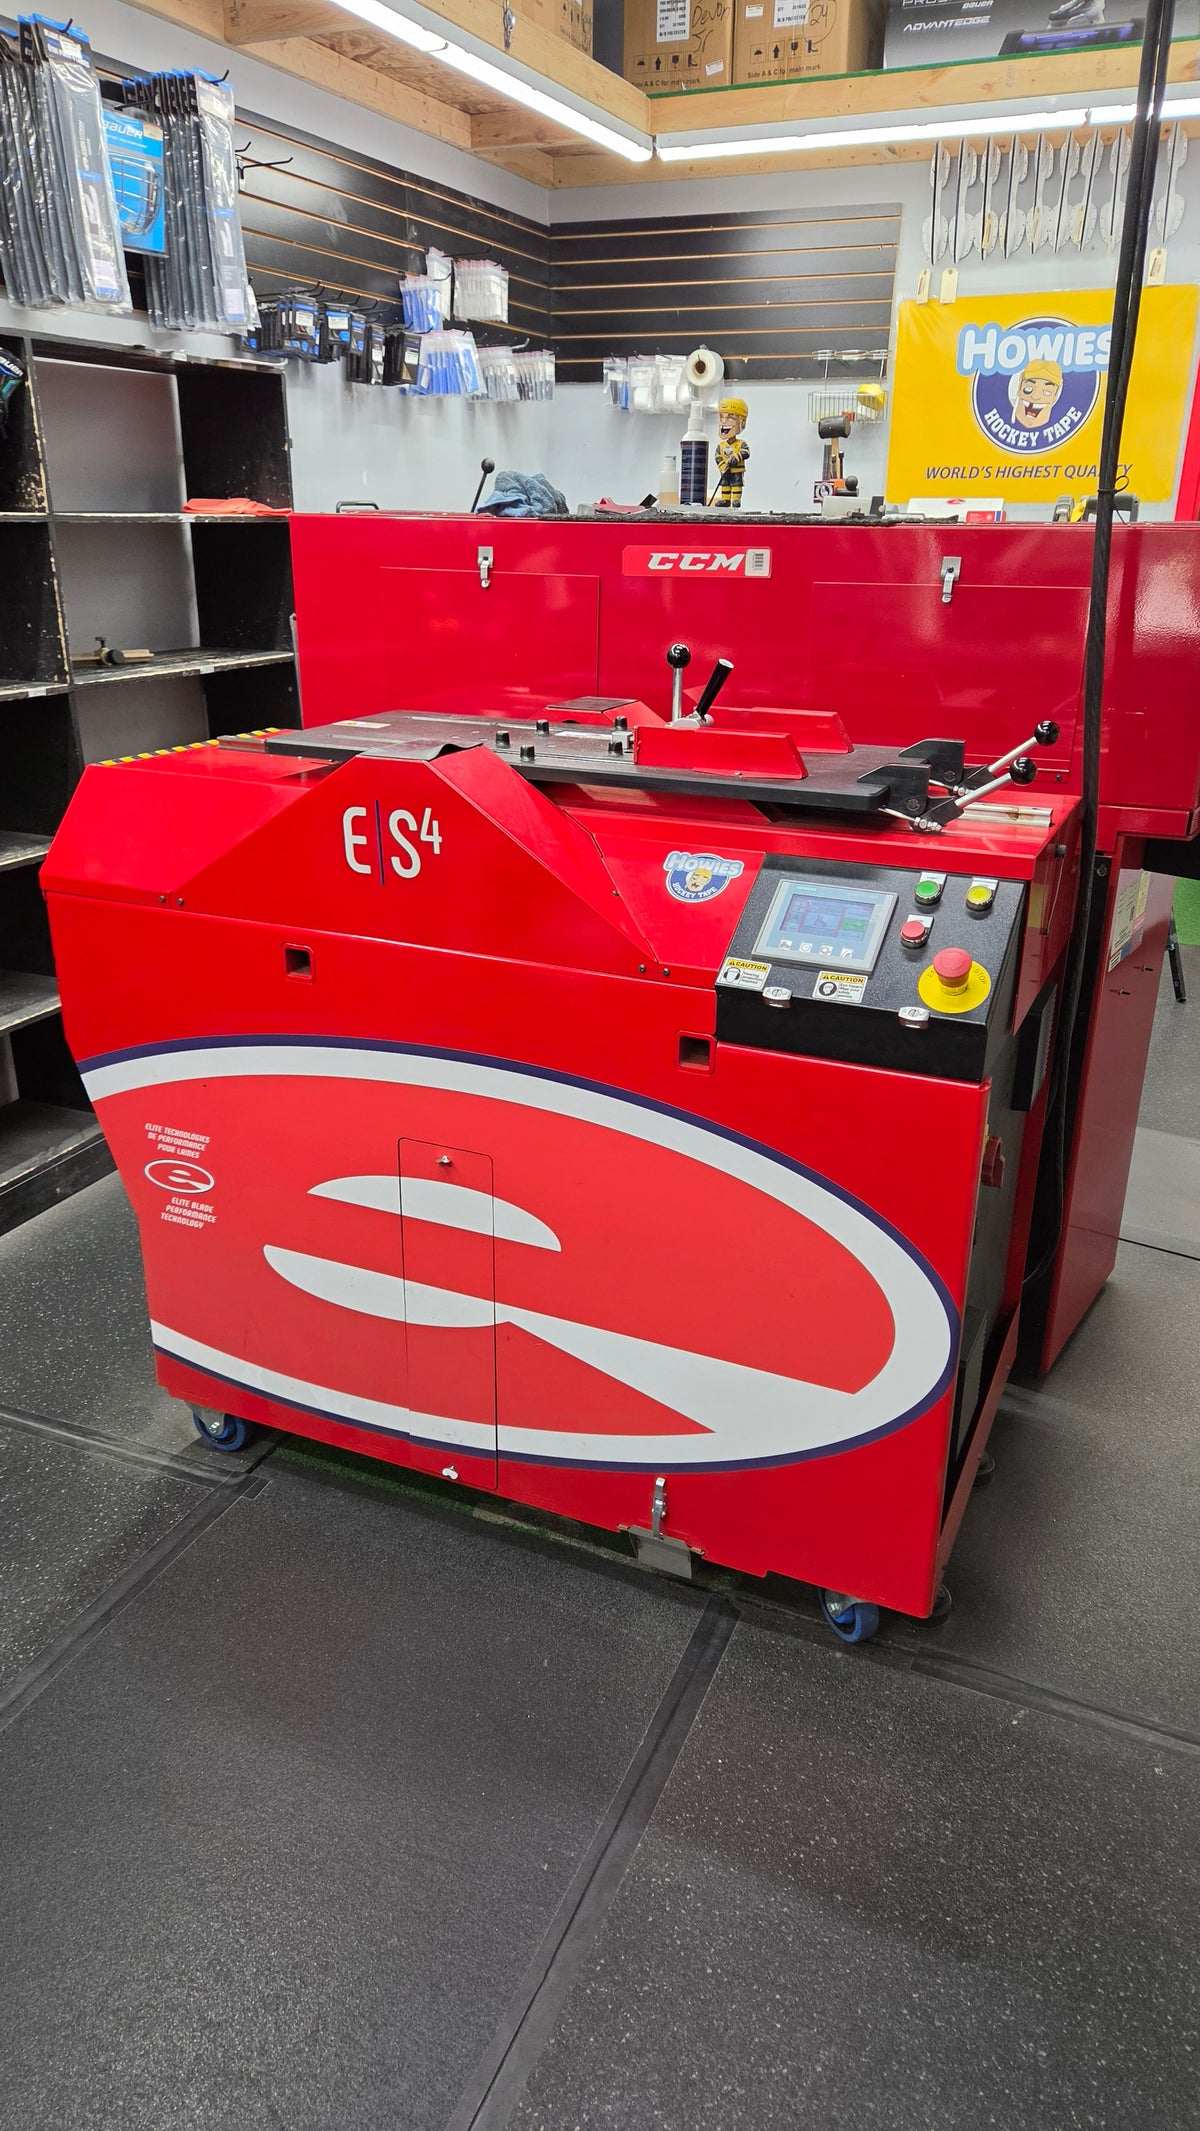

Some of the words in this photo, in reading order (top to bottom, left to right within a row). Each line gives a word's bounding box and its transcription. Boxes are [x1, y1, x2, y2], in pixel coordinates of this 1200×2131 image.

[903, 15, 992, 32] ADVANTEDGE
[747, 71, 760, 79] Side
[984, 407, 1040, 447] HOCKEY
[1044, 406, 1083, 443] TAPE
[925, 465, 993, 479] WORLD'S
[995, 465, 1061, 479] HIGHEST
[1064, 463, 1133, 479] QUAY
[648, 552, 745, 571] CCM
[668, 854, 740, 875] HOWIES
[672, 882, 697, 899] HOCKEY
[698, 886, 718, 898] TAPE
[736, 961, 768, 971] CAUTION
[830, 975, 864, 983] CAUTION
[145, 1123, 162, 1133] ELITE
[164, 1127, 211, 1144] TECHNOLOGIES
[148, 1132, 157, 1140] DE
[157, 1134, 206, 1151] PERFORMANCE
[157, 1143, 176, 1153] POUR
[177, 1148, 200, 1159] LAMES
[171, 1197, 190, 1207] ELITE
[191, 1202, 214, 1213] BLADE
[160, 1212, 204, 1229] TECHNOLOGY
[166, 1205, 217, 1223] PERFORMANCE
